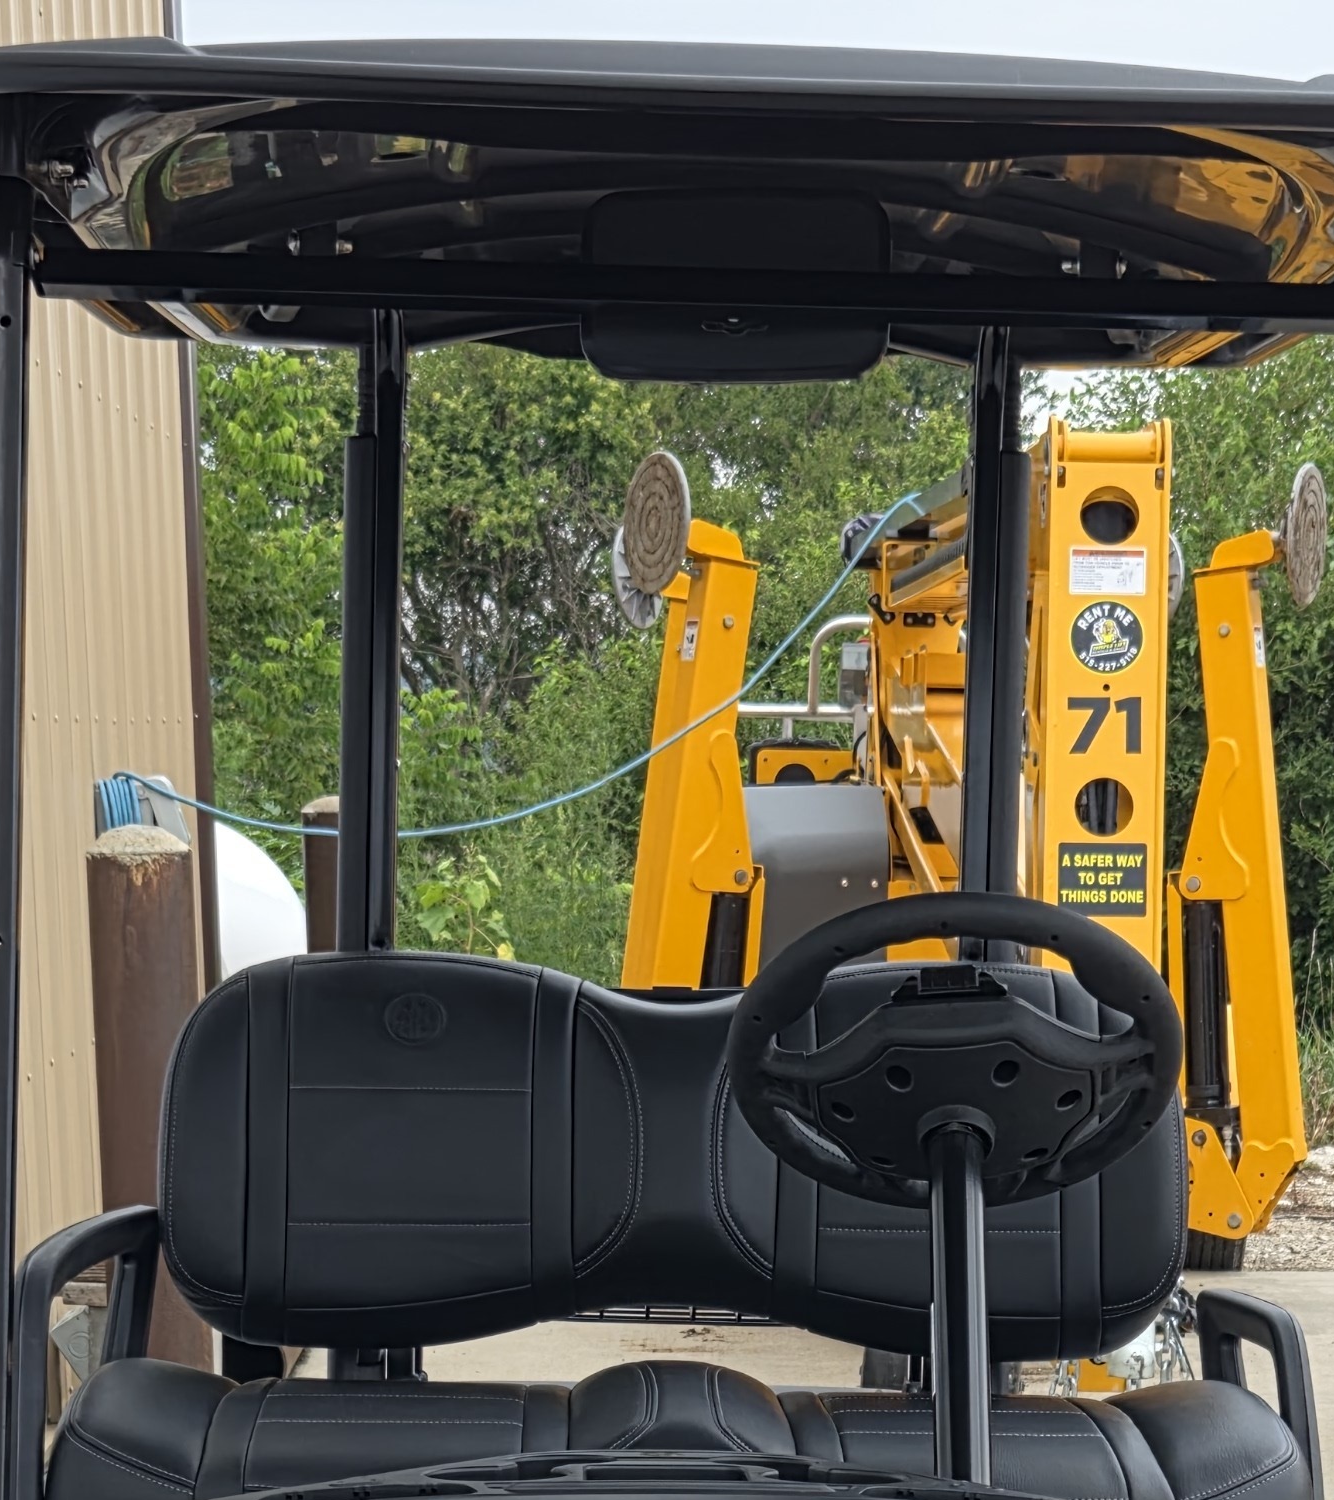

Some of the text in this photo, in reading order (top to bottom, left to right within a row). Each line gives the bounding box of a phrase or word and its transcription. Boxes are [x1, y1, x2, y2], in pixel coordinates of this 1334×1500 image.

[1077, 605, 1133, 630] RENT ME
[1067, 697, 1142, 755] 71
[1062, 854, 1143, 867] A SAFER WAY
[1078, 872, 1123, 885] TO GET
[1060, 890, 1144, 903] THINGS DONE
